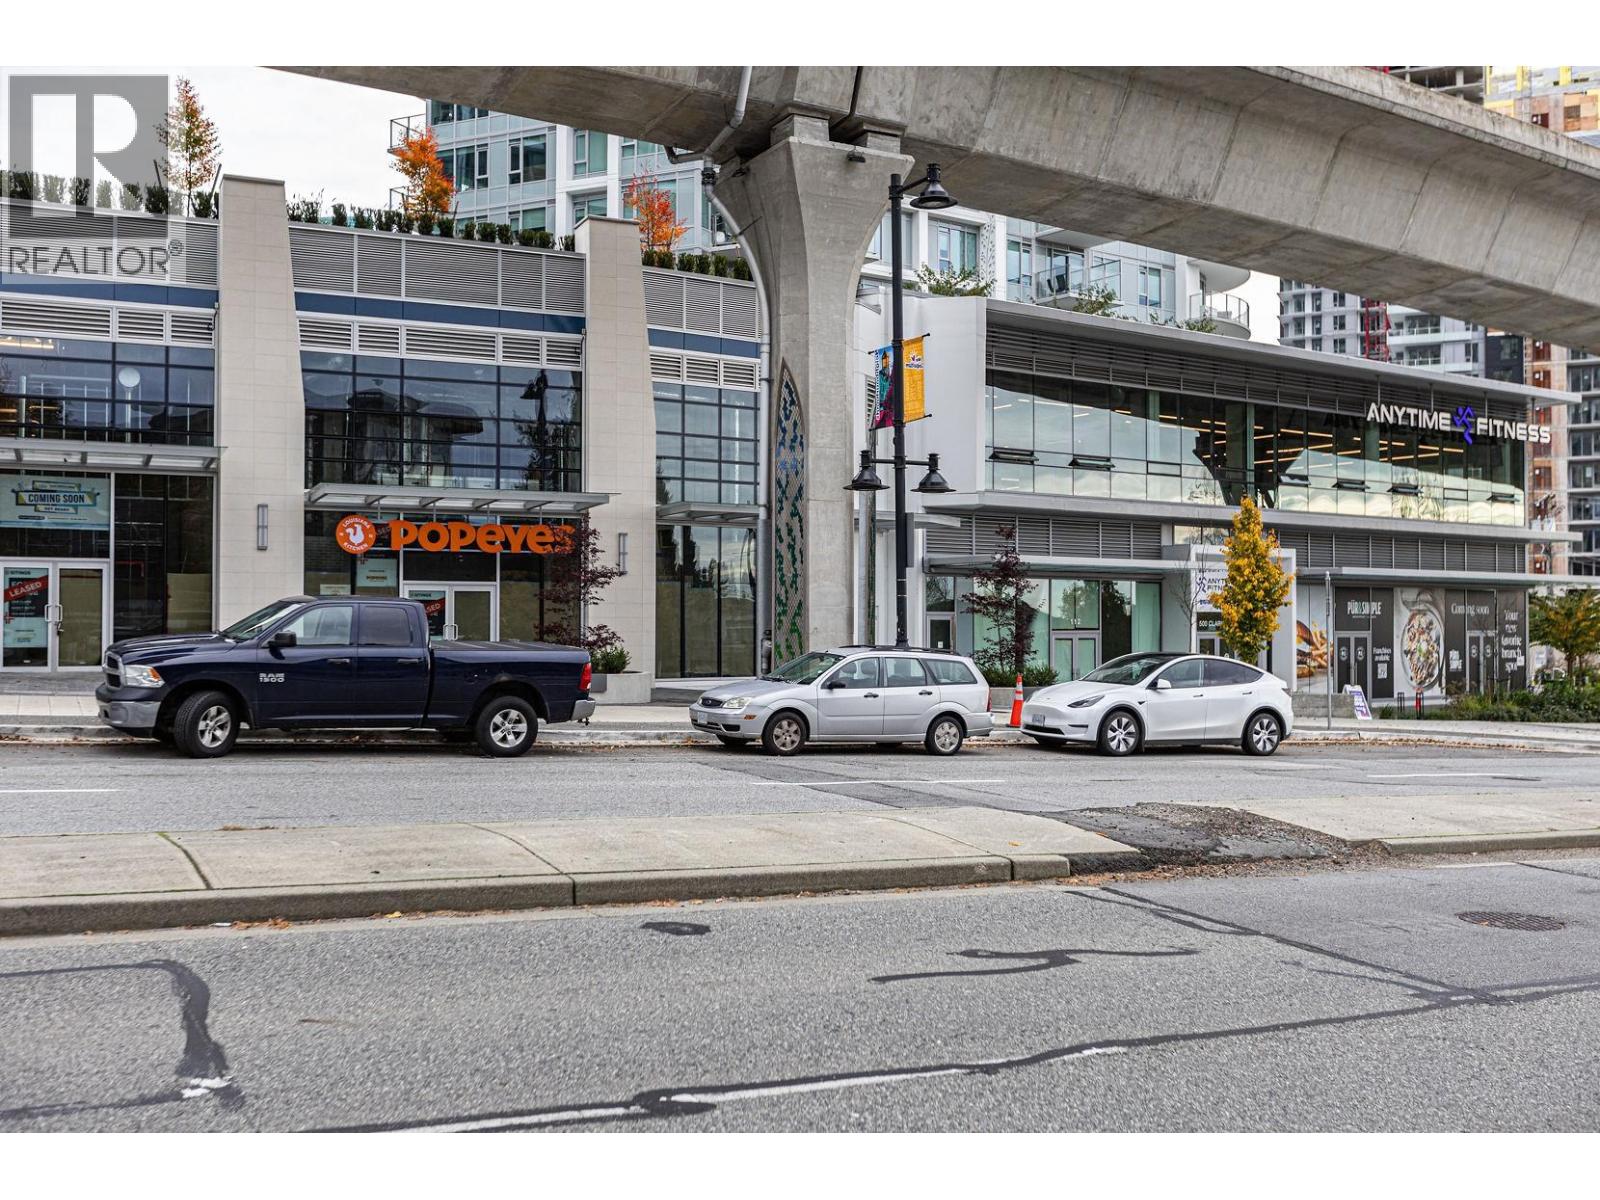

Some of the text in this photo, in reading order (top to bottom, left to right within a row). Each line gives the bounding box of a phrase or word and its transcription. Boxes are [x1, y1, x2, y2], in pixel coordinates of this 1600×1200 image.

[1366, 402, 1551, 444] ANYTIME FITNESS
[28, 493, 85, 503] COMING SOON
[8, 581, 42, 597] LEASED
[1504, 609, 1519, 621] Your
